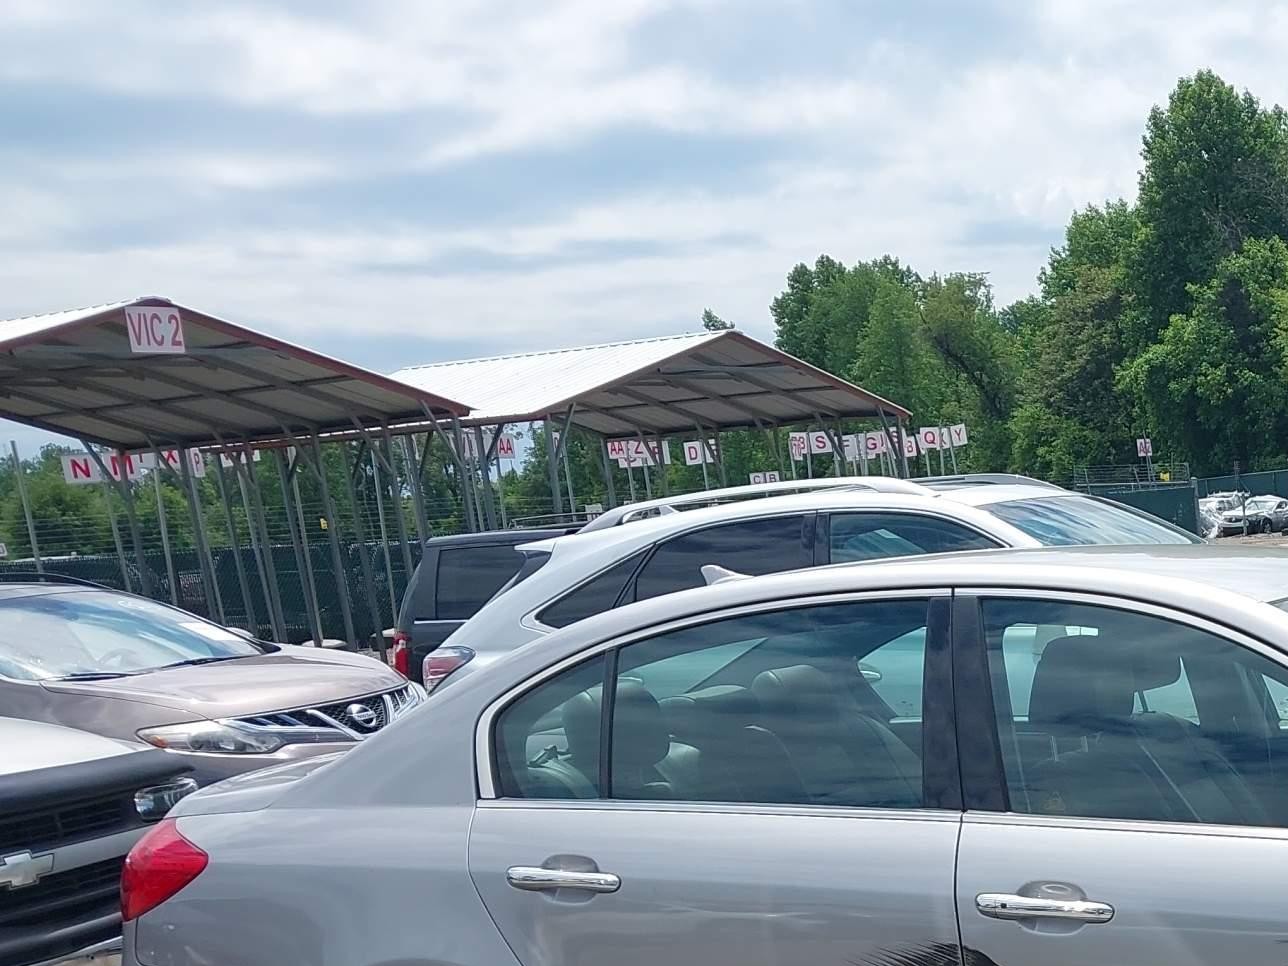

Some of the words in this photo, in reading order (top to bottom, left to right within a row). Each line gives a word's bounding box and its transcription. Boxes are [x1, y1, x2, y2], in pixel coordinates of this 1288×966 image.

[127, 312, 165, 346] VIC
[167, 313, 183, 346] 2
[815, 435, 826, 449] S
[866, 436, 877, 450] G
[924, 431, 936, 444] Q
[610, 441, 625, 455] AA
[688, 446, 698, 460] D
[70, 458, 91, 479] N
